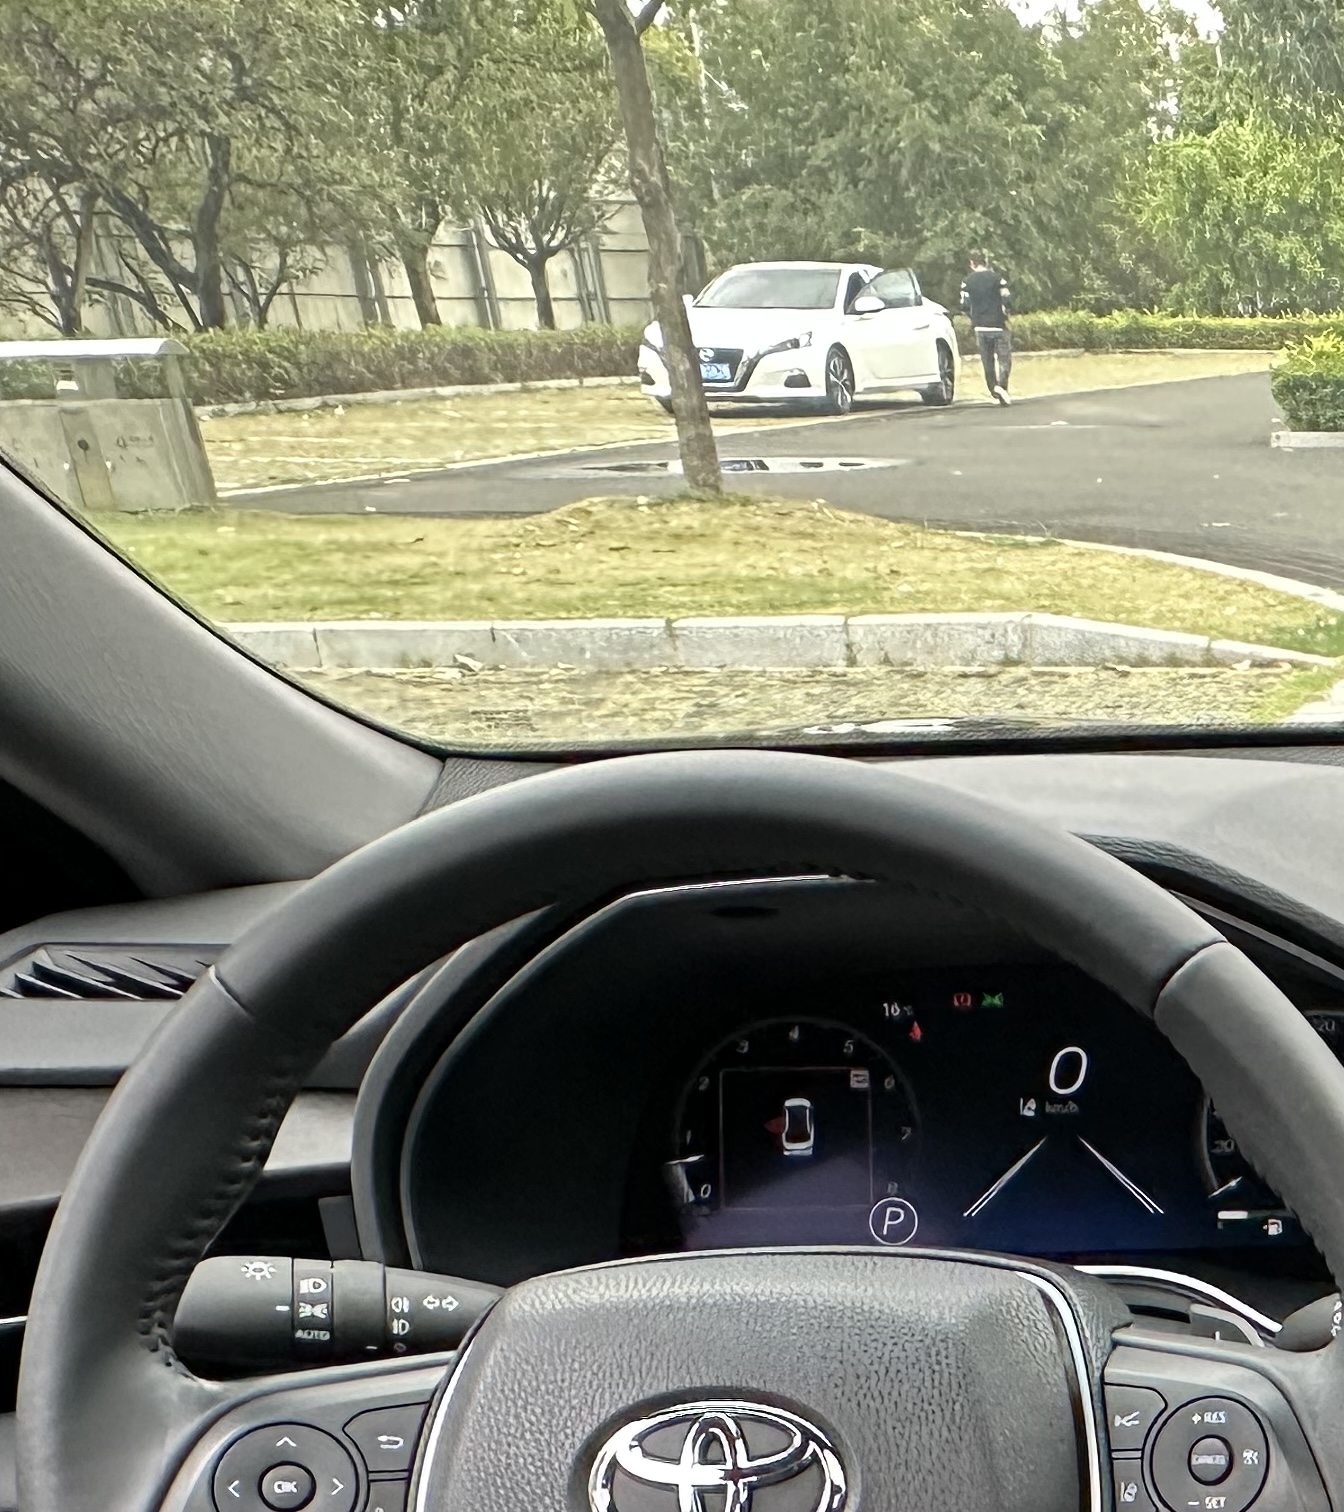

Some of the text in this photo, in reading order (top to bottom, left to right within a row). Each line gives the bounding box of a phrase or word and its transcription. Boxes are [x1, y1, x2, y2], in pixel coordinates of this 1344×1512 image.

[1049, 1046, 1088, 1094] 0
[883, 1207, 904, 1236] P
[295, 1329, 331, 1341] AUTO
[274, 1480, 298, 1494] OK
